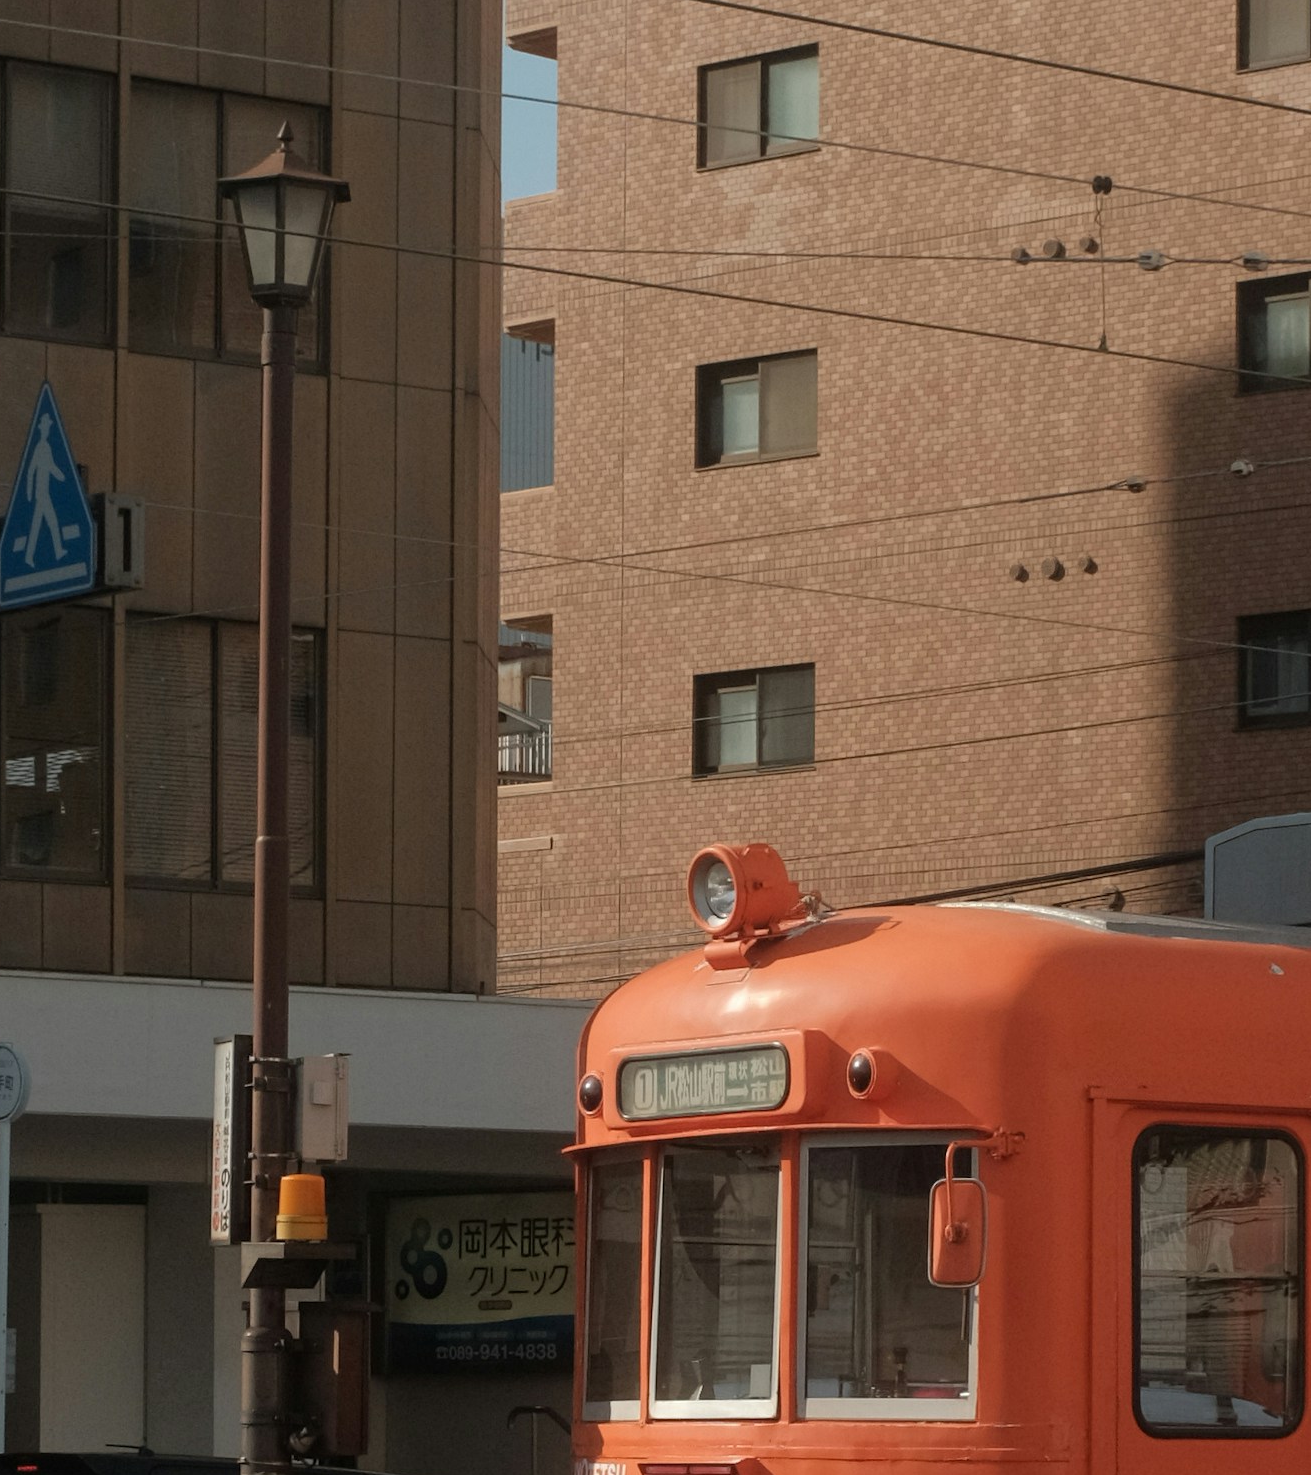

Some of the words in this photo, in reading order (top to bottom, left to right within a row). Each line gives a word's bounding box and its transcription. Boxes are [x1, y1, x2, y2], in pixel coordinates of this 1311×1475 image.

[751, 1055, 785, 1077] 松山
[660, 1062, 726, 1110] JR松山駅前
[459, 1218, 576, 1259] 岡本眼科
[469, 1266, 569, 1296] クリニック
[448, 1343, 557, 1361] 089-941-4838
